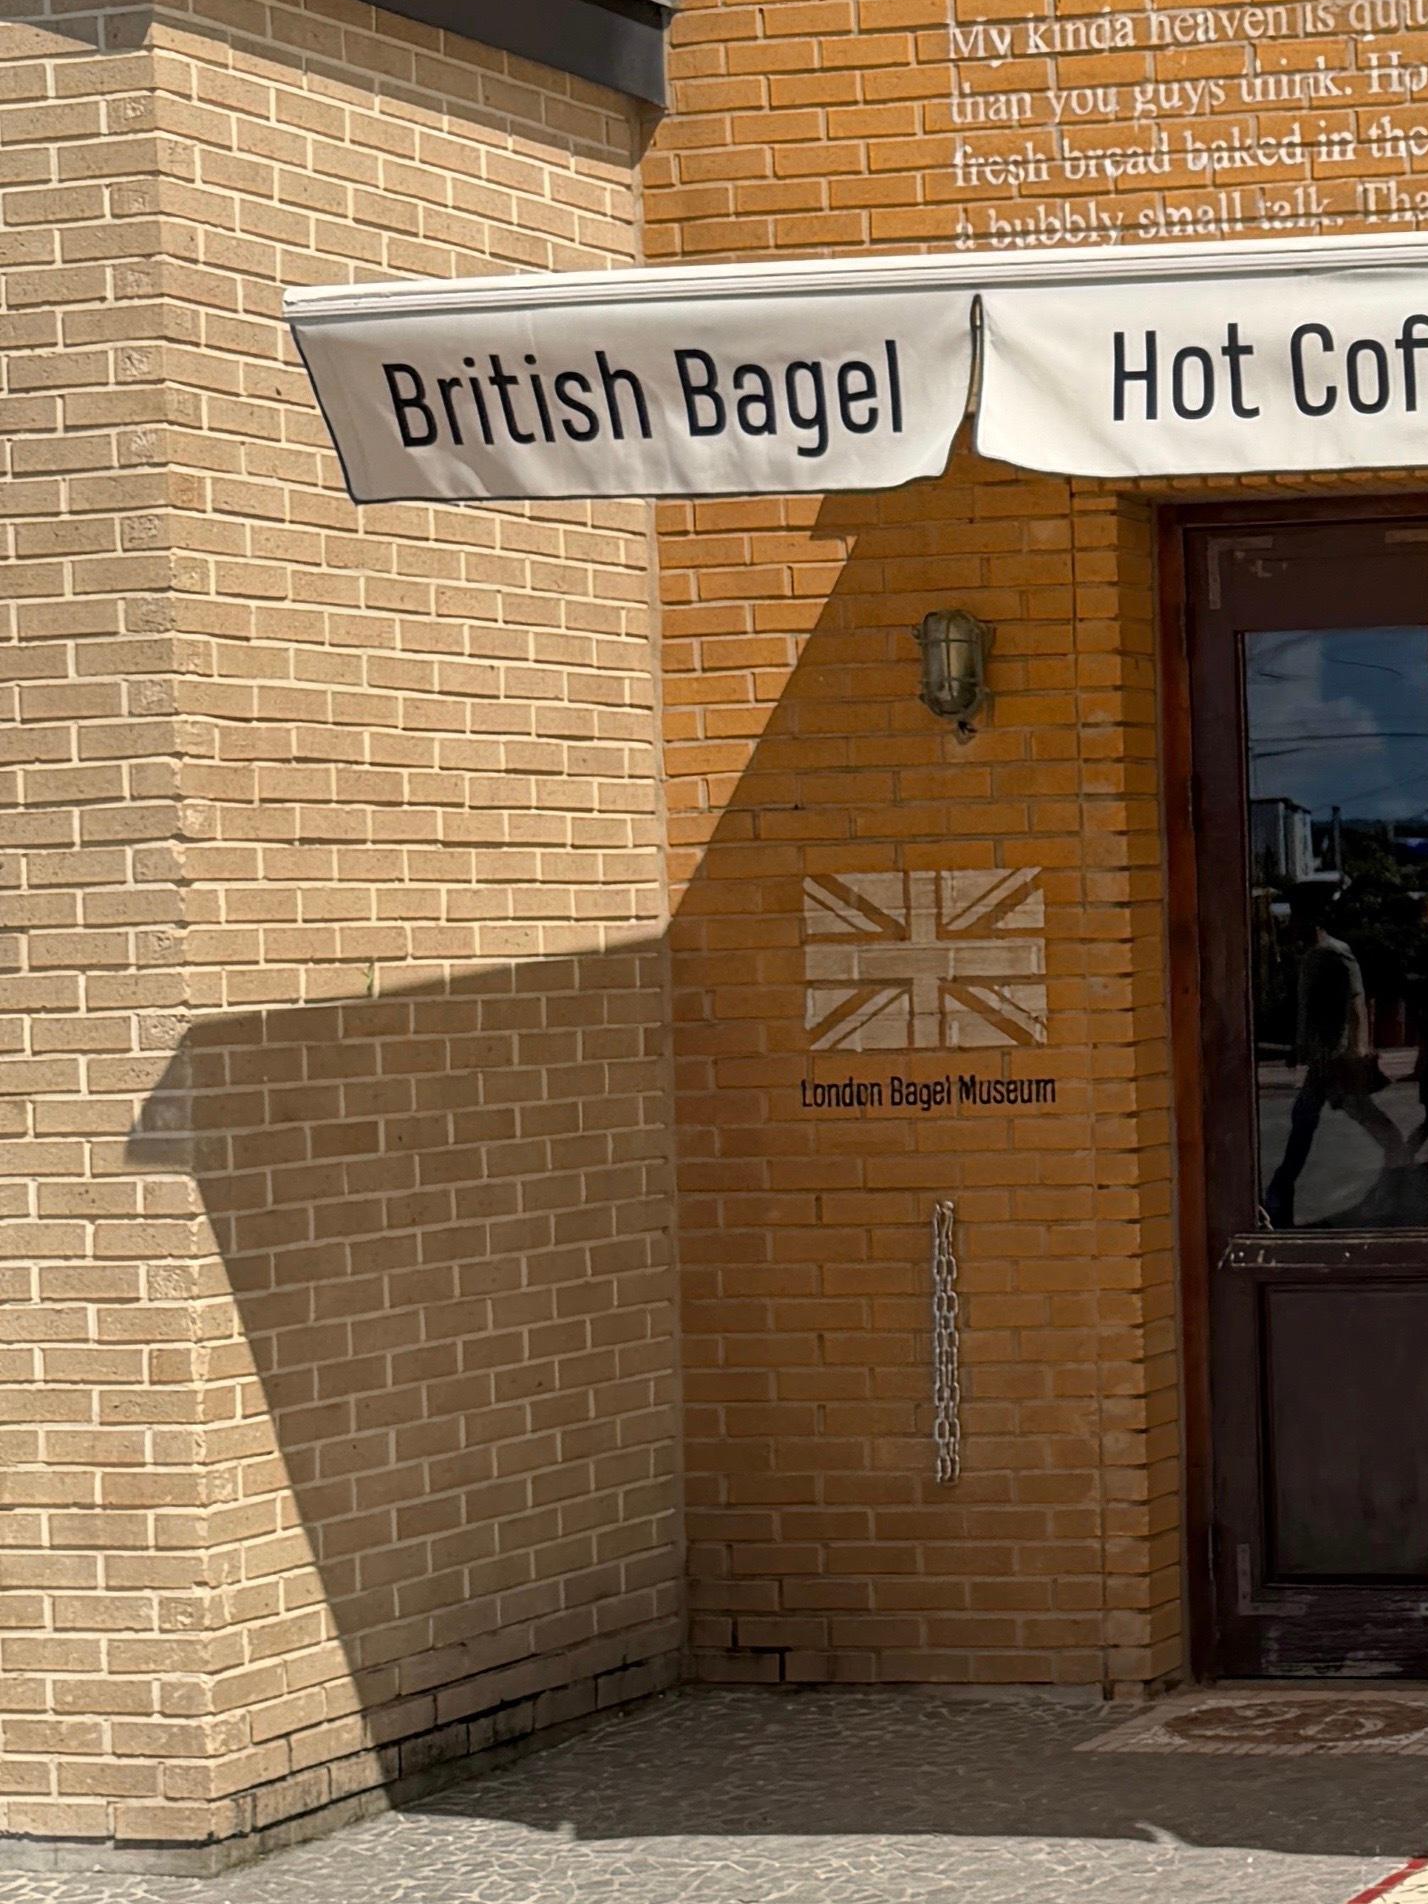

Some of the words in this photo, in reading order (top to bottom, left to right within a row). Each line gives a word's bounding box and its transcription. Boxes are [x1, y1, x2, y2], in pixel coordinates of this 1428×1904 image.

[947, 14, 1011, 67] My
[1026, 6, 1136, 54] kinda
[1148, 1, 1290, 46] heaven
[950, 80, 1032, 124] than
[1048, 82, 1118, 124] you
[1133, 75, 1227, 127] guys
[1241, 55, 1353, 103] think.
[954, 140, 1050, 187] fresh
[1063, 132, 1171, 181] bread
[1183, 122, 1306, 171] baked
[1318, 120, 1356, 162] in
[1367, 115, 1428, 158] the
[954, 219, 976, 251] a
[989, 200, 1124, 250] bubbly
[1139, 191, 1243, 240] small
[1258, 186, 1345, 232] talk.
[382, 350, 653, 450] British
[674, 339, 904, 458] Bagel
[1112, 322, 1260, 422] Hot
[800, 1077, 883, 1108] London
[890, 1074, 951, 1111] Bagel
[958, 1074, 1056, 1104] Museum
